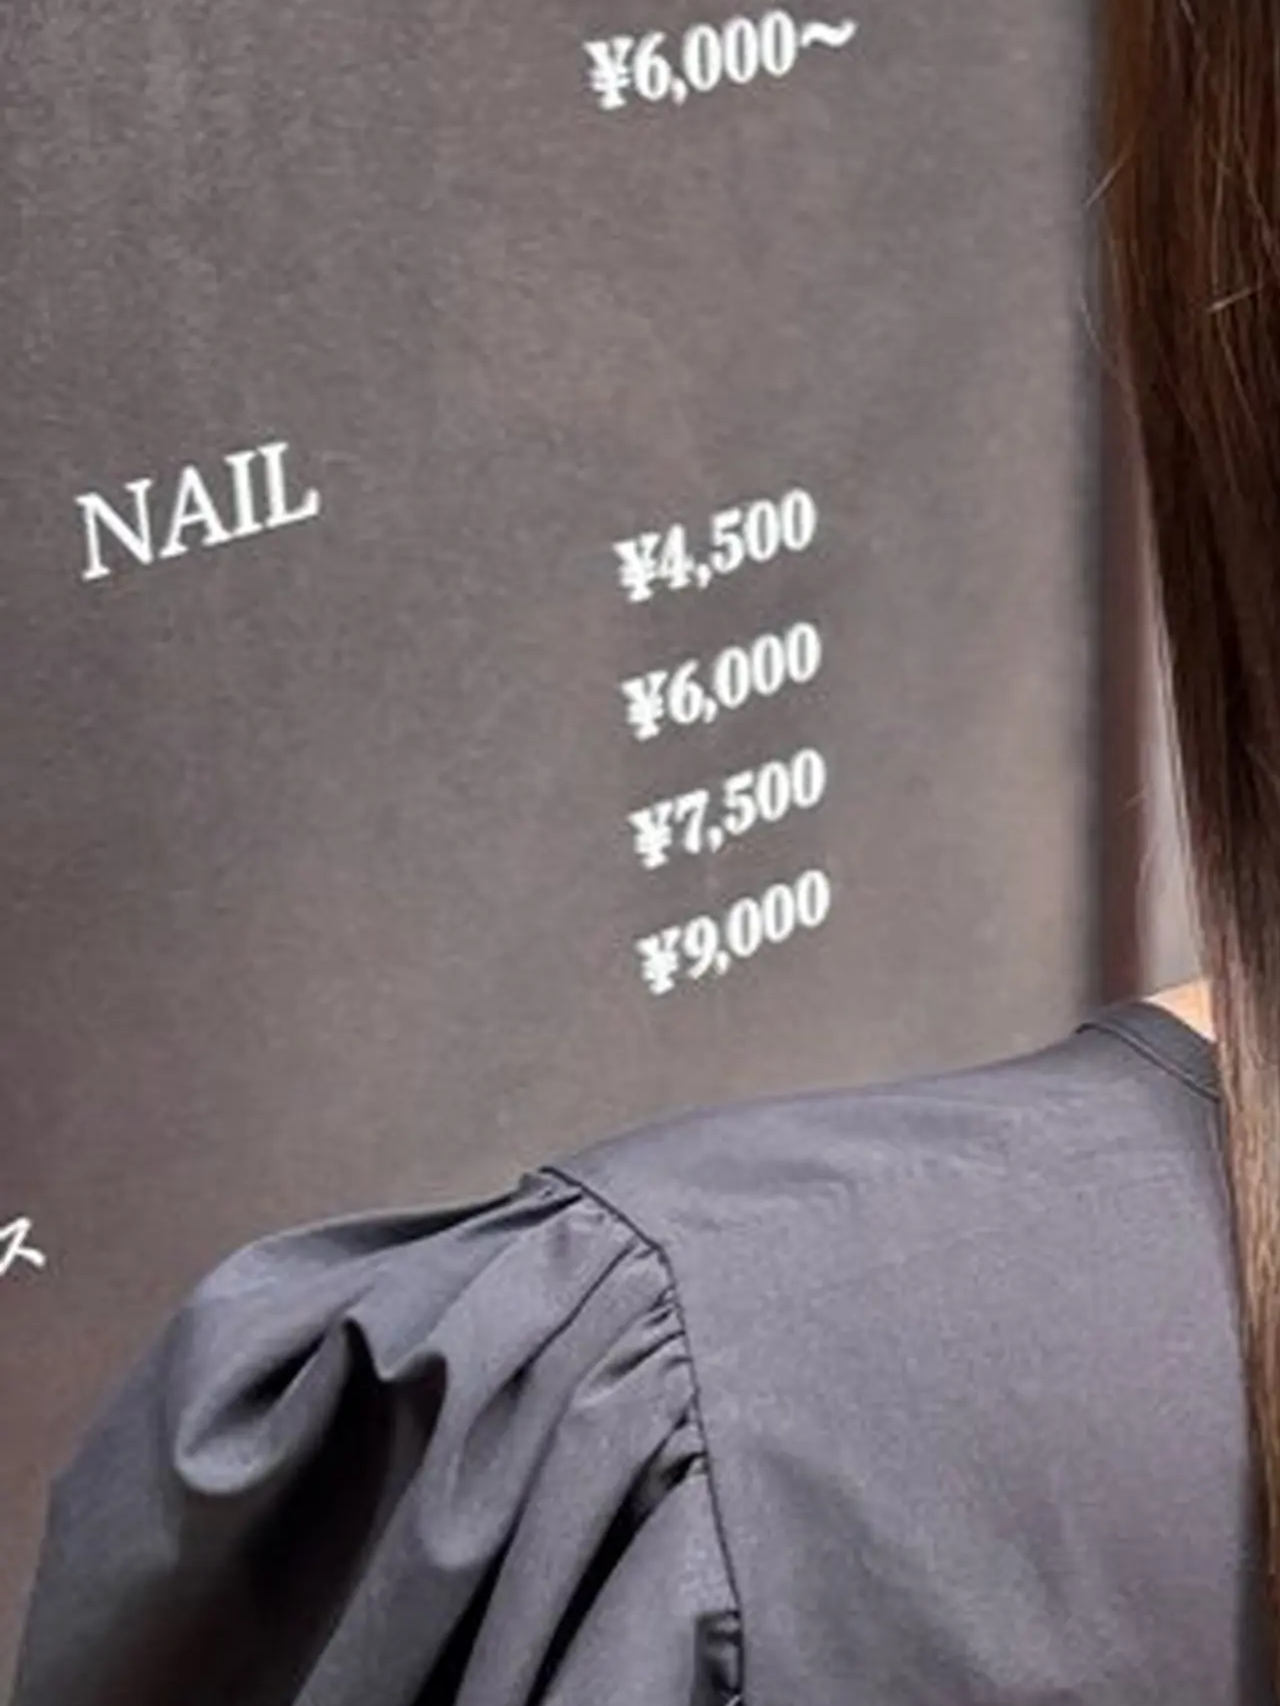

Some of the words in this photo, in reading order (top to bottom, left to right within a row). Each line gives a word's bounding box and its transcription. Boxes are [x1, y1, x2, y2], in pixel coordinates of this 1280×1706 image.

[75, 441, 320, 581] NAIL
[613, 488, 817, 603] ¥4,500
[621, 622, 822, 740] ¥6,000
[628, 748, 826, 869] ¥7,500
[637, 869, 831, 995] ¥9,000
